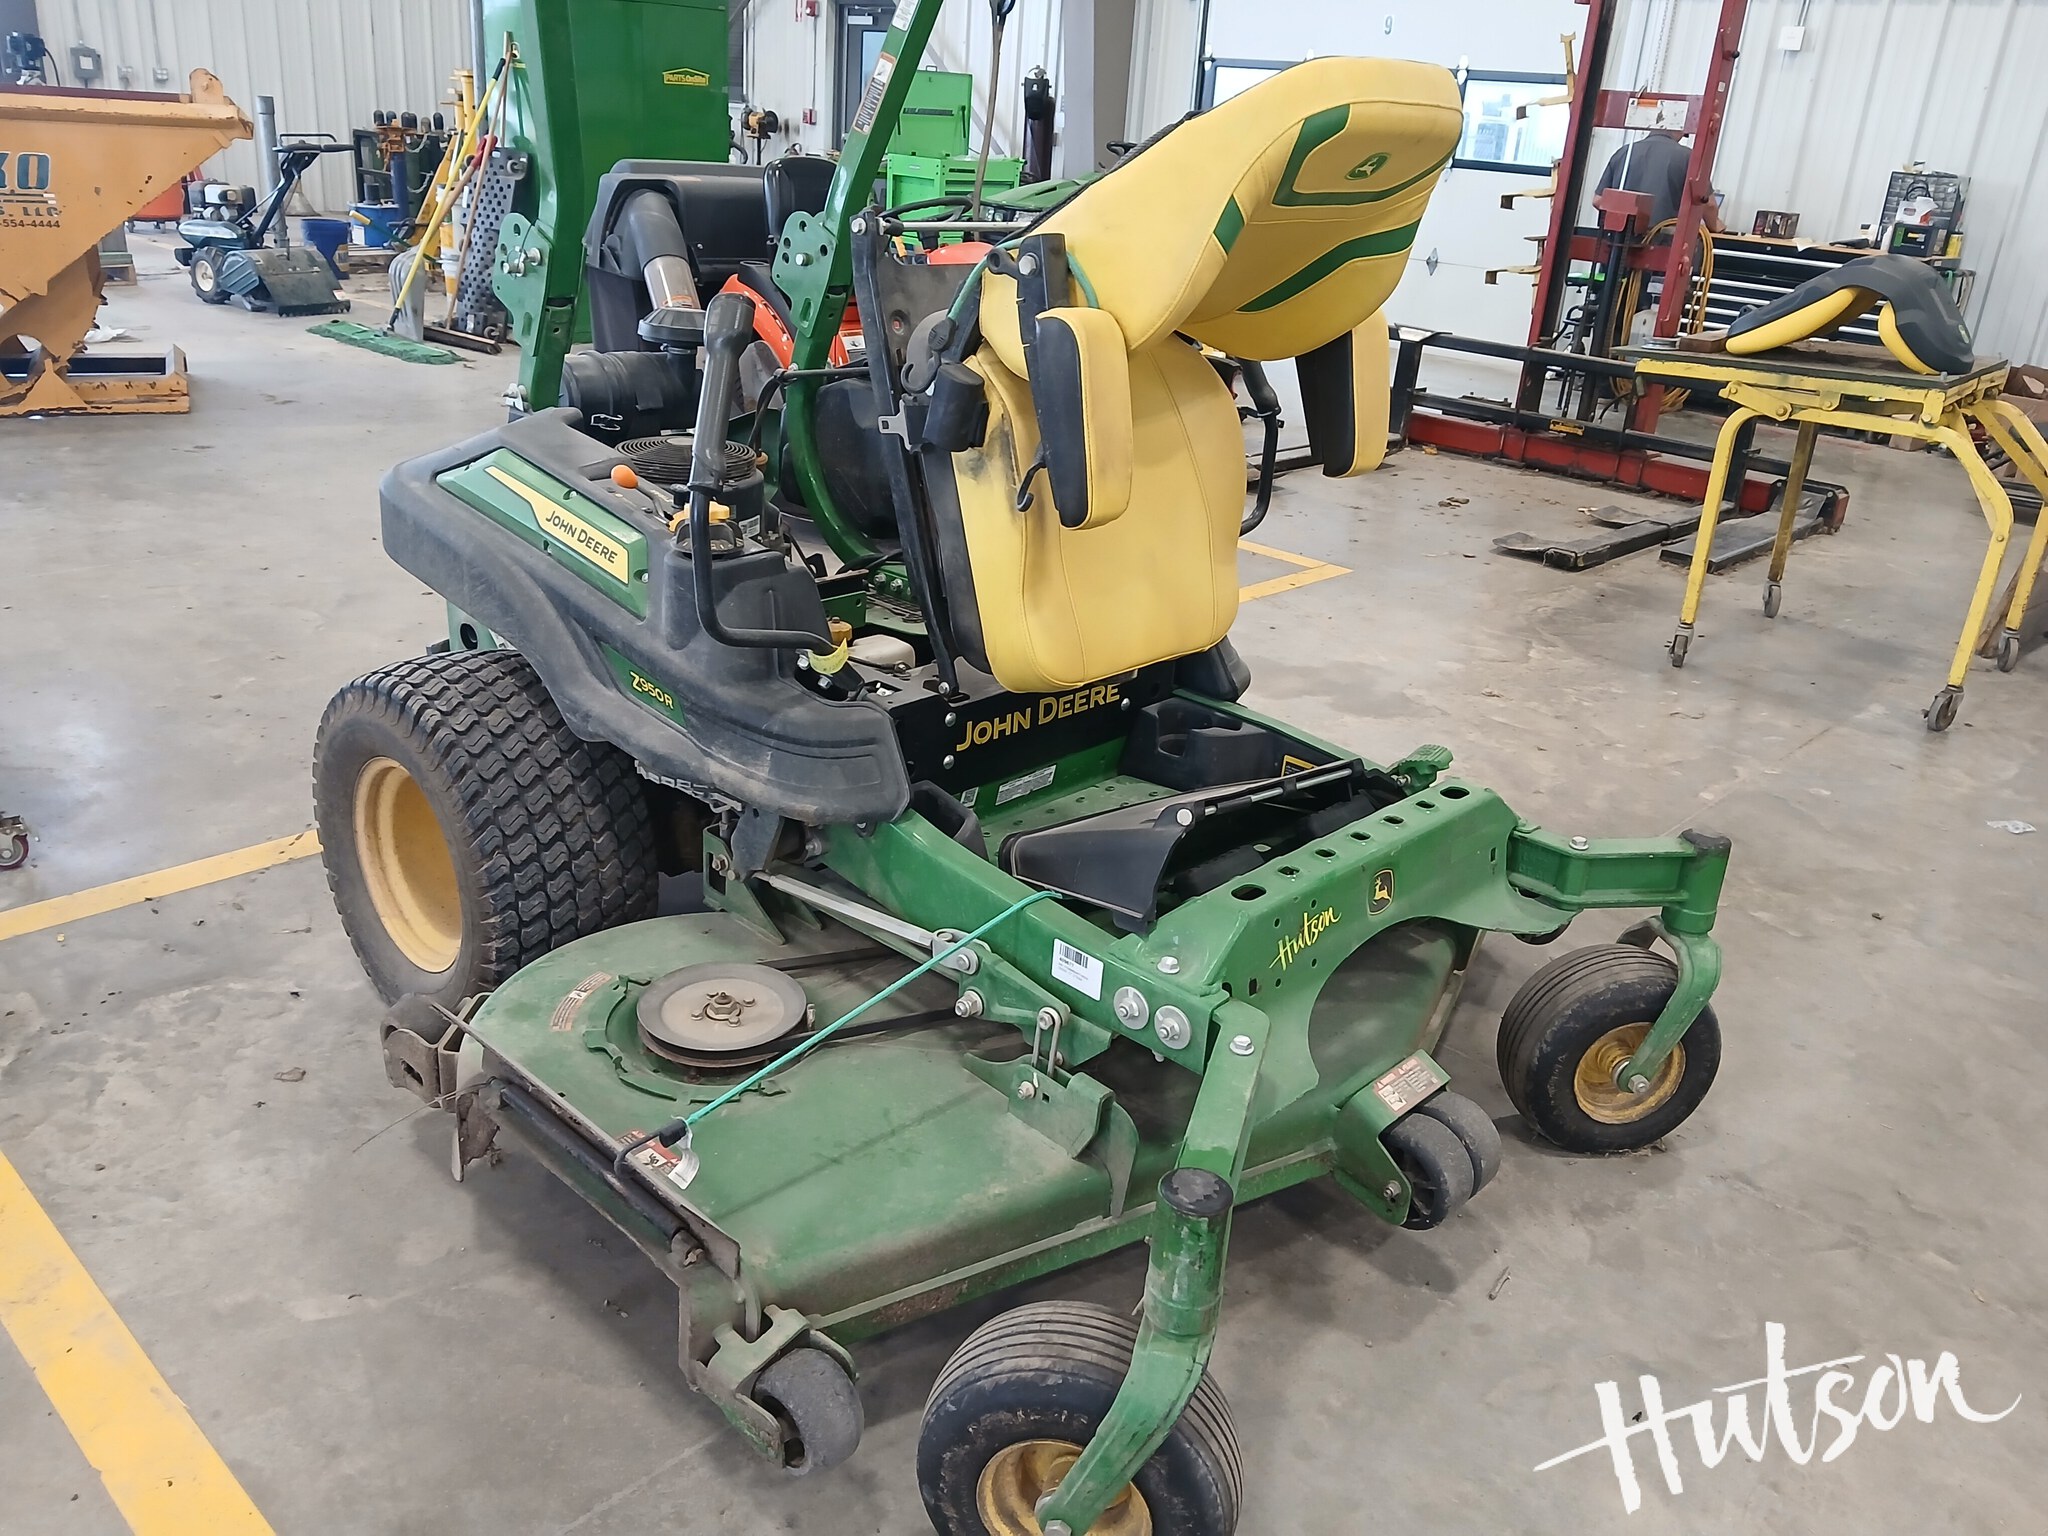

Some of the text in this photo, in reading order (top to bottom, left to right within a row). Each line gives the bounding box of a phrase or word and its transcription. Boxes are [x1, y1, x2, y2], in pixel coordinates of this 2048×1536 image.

[1384, 15, 1393, 35] 9
[545, 510, 618, 564] JOHN DEERE
[630, 671, 674, 709] Z950R
[956, 683, 1121, 752] JOHN DEERE
[1268, 906, 1342, 972] Hutson
